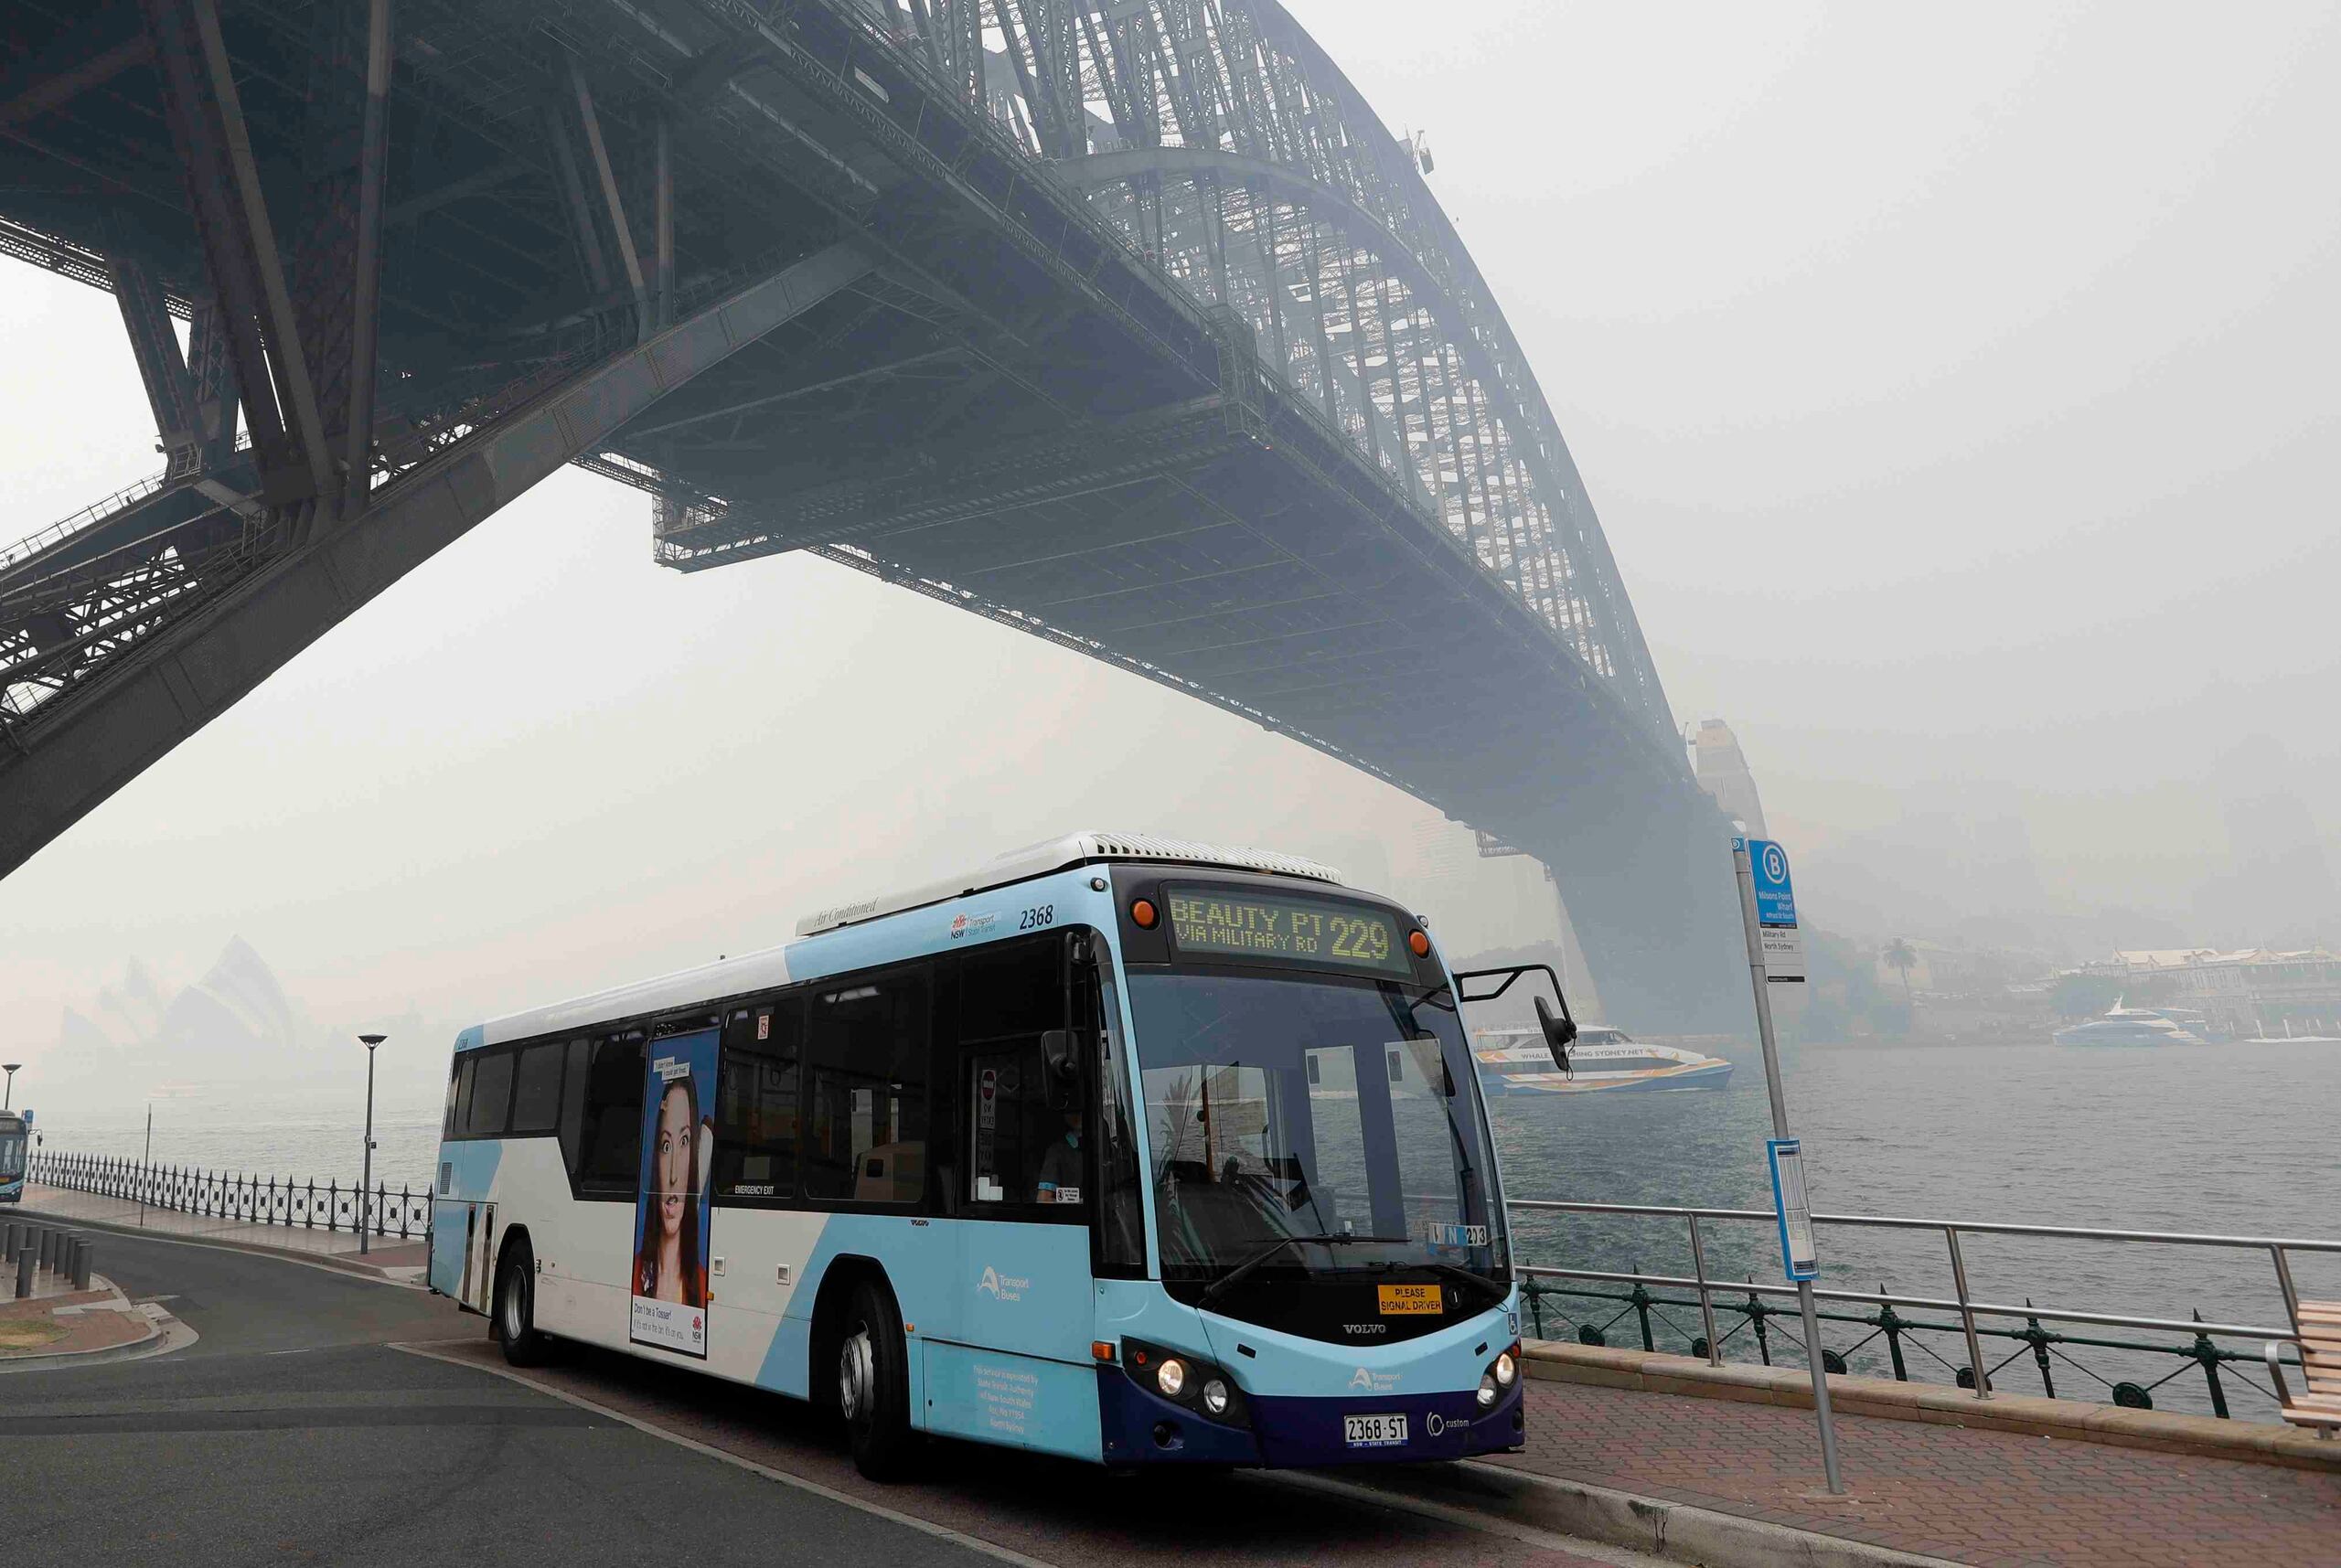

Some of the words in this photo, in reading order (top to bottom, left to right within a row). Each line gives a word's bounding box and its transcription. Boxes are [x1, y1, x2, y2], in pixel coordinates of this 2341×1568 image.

[814, 910, 829, 927] Air
[828, 896, 879, 923] Conditioned
[968, 914, 995, 927] Transport
[1019, 904, 1054, 931] 2368
[1170, 899, 1279, 931] BEAUTY
[1291, 912, 1323, 936] PT
[951, 929, 966, 940] NSW
[1176, 923, 1207, 943] VIA
[1212, 927, 1290, 951] MILITARY
[1296, 936, 1318, 954] RD
[1330, 917, 1390, 960] 229
[734, 1185, 764, 1195] EMERGENCY
[764, 1185, 775, 1196] EXIT
[999, 1275, 1030, 1289] Transport
[1000, 1288, 1021, 1302] Buses
[1395, 1288, 1426, 1298] PLEASE
[1381, 1300, 1411, 1311] SIGNAL
[1412, 1300, 1441, 1310] DRIVER
[646, 1306, 652, 1317] be
[1342, 1324, 1386, 1334] VOLVO
[692, 1330, 702, 1340] NSW
[1373, 1372, 1402, 1381] Transport
[1446, 1419, 1470, 1427] custom
